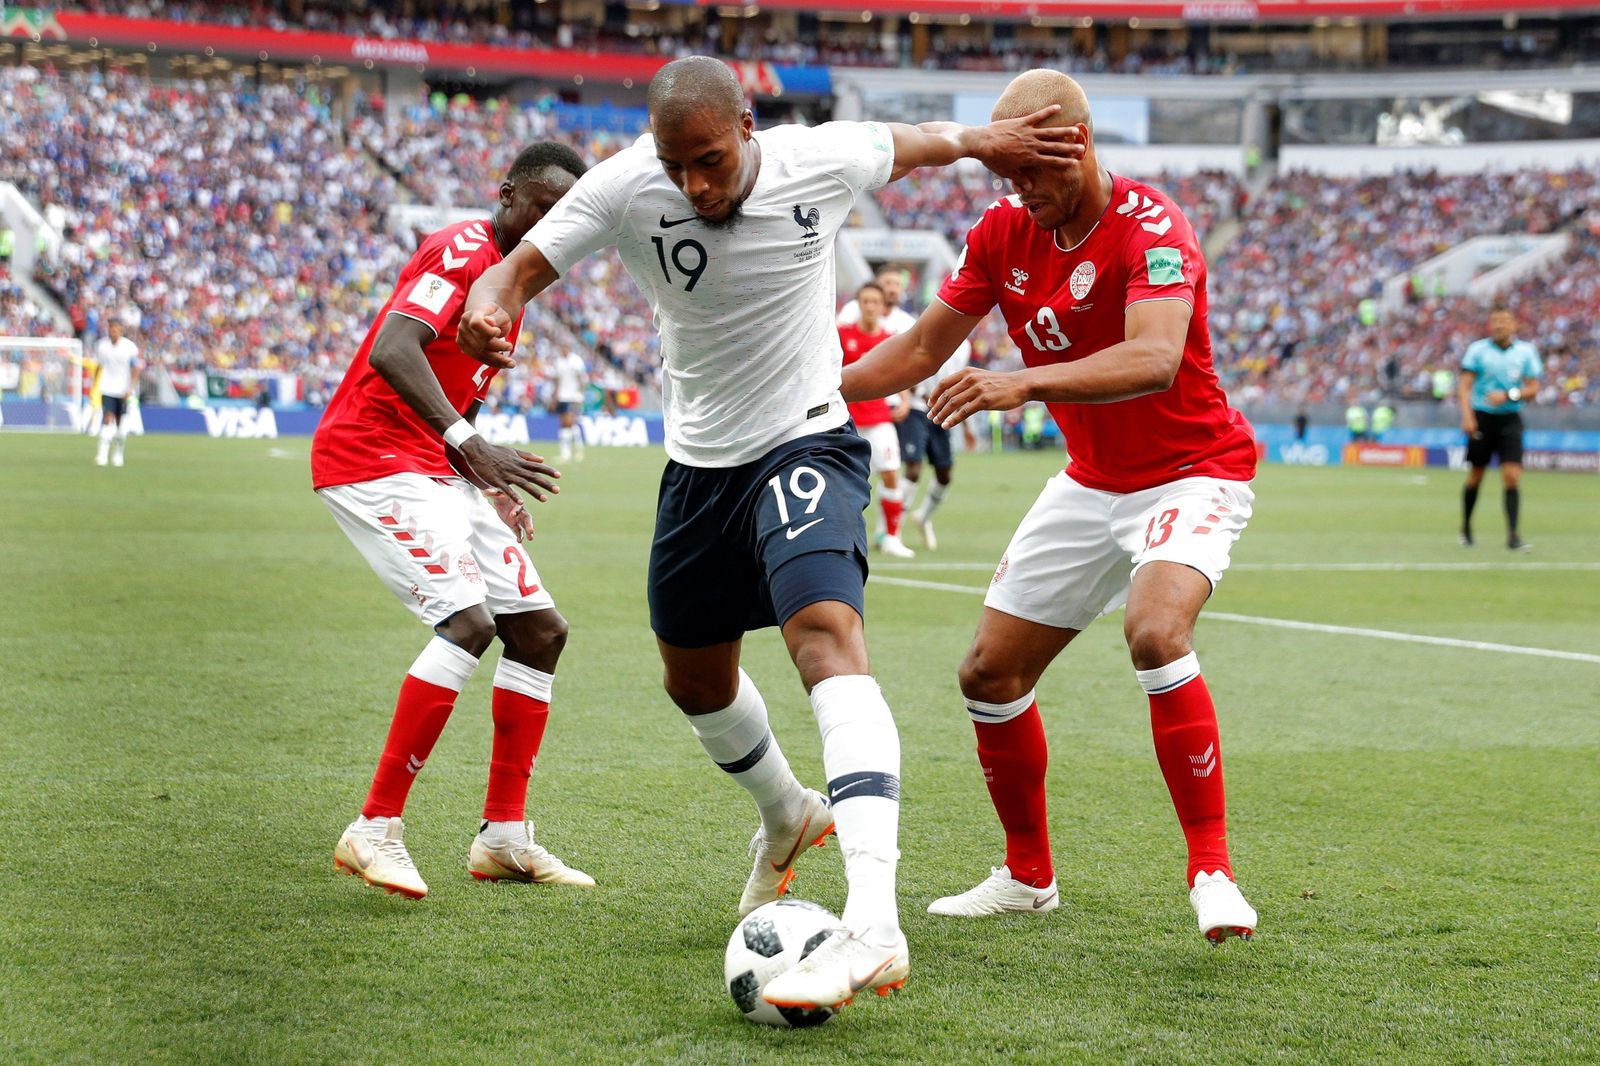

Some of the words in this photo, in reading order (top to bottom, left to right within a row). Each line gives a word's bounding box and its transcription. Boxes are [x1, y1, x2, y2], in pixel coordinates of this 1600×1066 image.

[651, 235, 708, 292] 19
[1024, 306, 1072, 352] 13
[203, 407, 279, 438] VISA
[577, 415, 650, 447] VISA
[768, 466, 827, 525] 19
[1143, 508, 1180, 553] 13
[503, 545, 540, 598] 2
